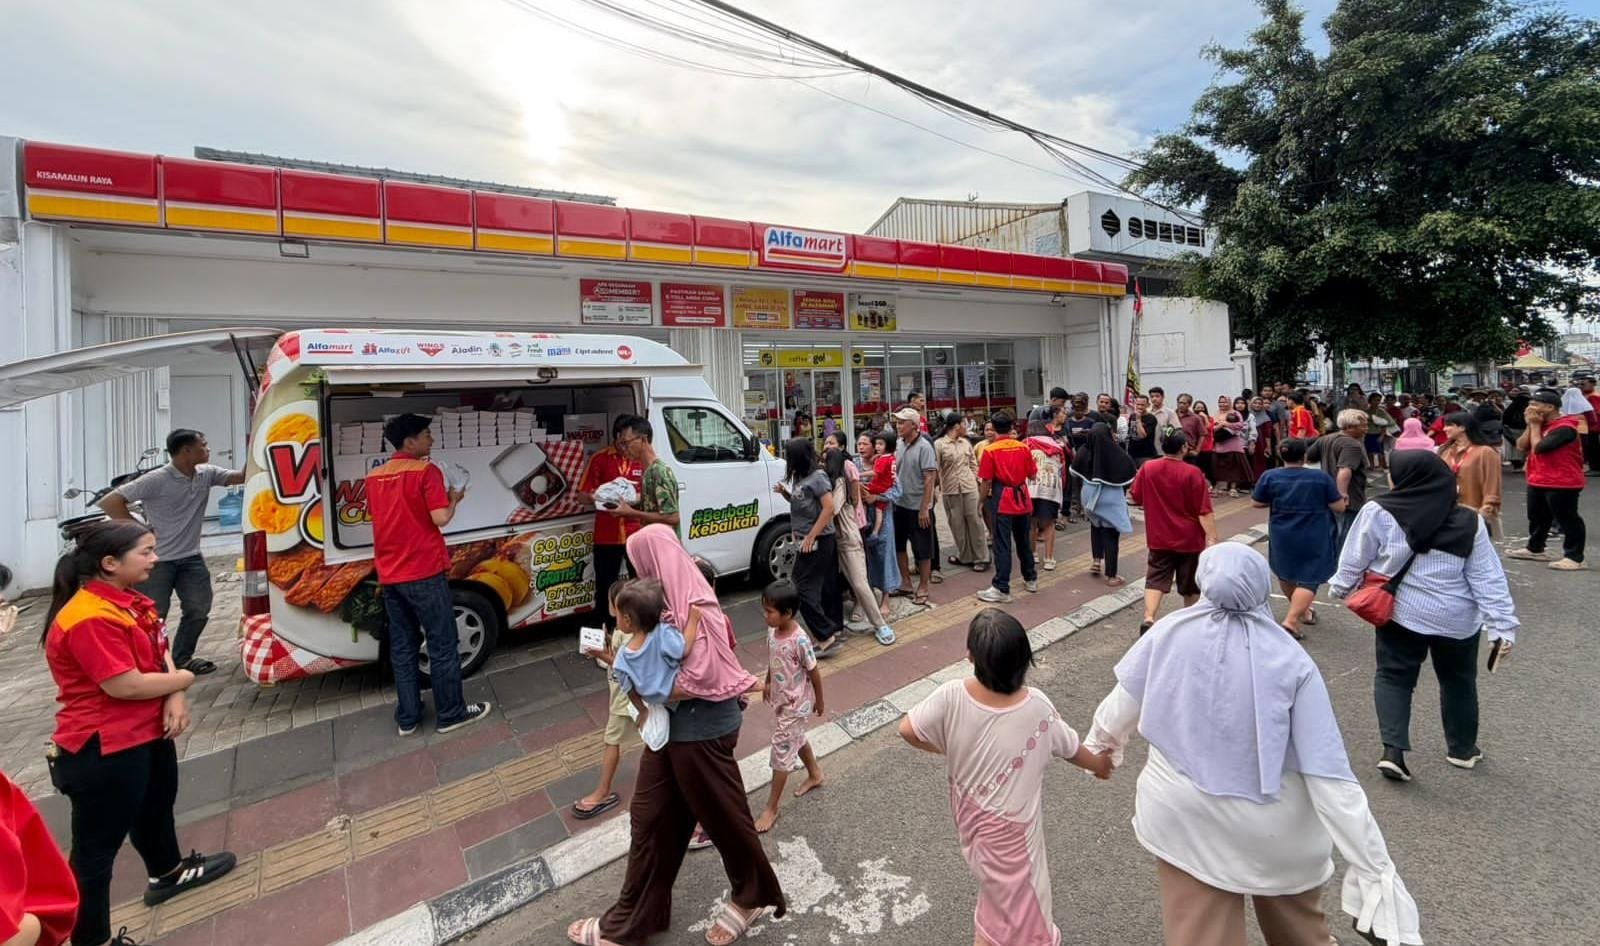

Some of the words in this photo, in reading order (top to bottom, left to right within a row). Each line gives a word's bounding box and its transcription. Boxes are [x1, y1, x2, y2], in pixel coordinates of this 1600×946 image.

[36, 170, 88, 183] KISAMAUN
[89, 176, 113, 185] RAYA
[767, 229, 843, 252] Alfamart
[307, 342, 353, 350] Alfamart
[692, 498, 759, 524] #Berbagi
[689, 515, 760, 539] Kebaikan
